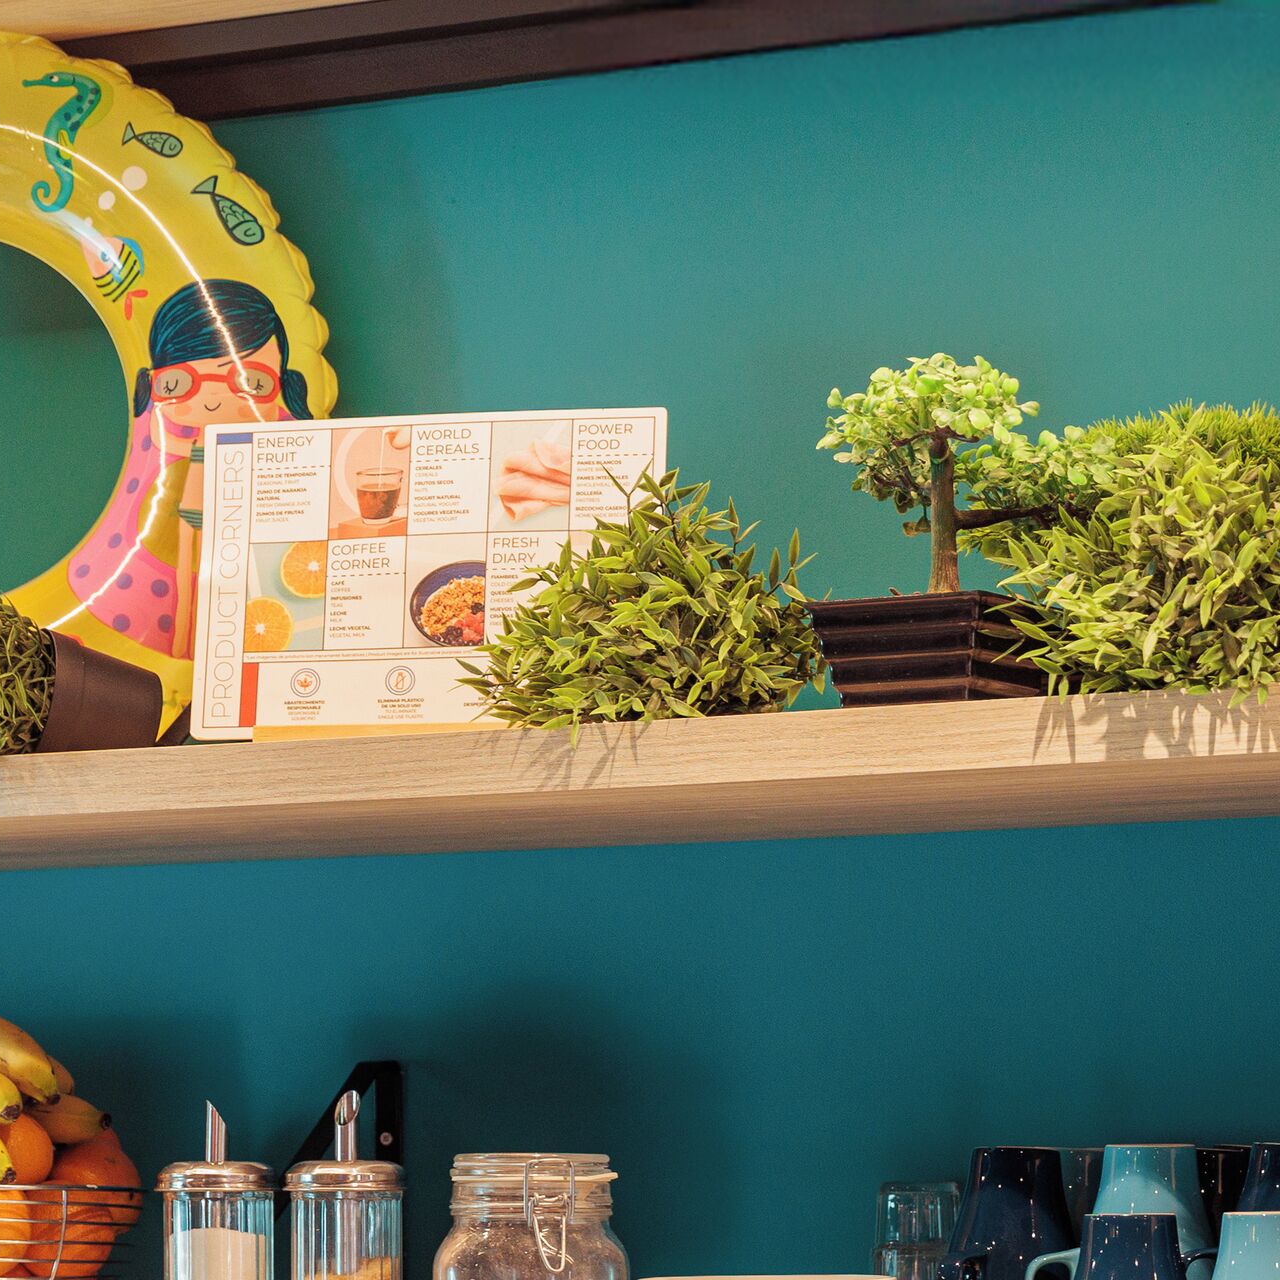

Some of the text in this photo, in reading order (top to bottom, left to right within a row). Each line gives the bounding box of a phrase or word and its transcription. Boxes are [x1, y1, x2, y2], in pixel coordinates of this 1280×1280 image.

[417, 429, 472, 440] WORLD
[579, 424, 633, 435] POWER
[257, 436, 314, 448] ENERGY
[578, 439, 620, 450] FOOD
[416, 443, 480, 455] CEREALS
[257, 452, 296, 463] FRUIT
[493, 537, 539, 548] FRESH
[332, 543, 386, 556] COFFEE
[493, 553, 536, 563] DIARY
[331, 558, 390, 570] CORNER
[211, 450, 244, 718] PRODUCT CORNERS
